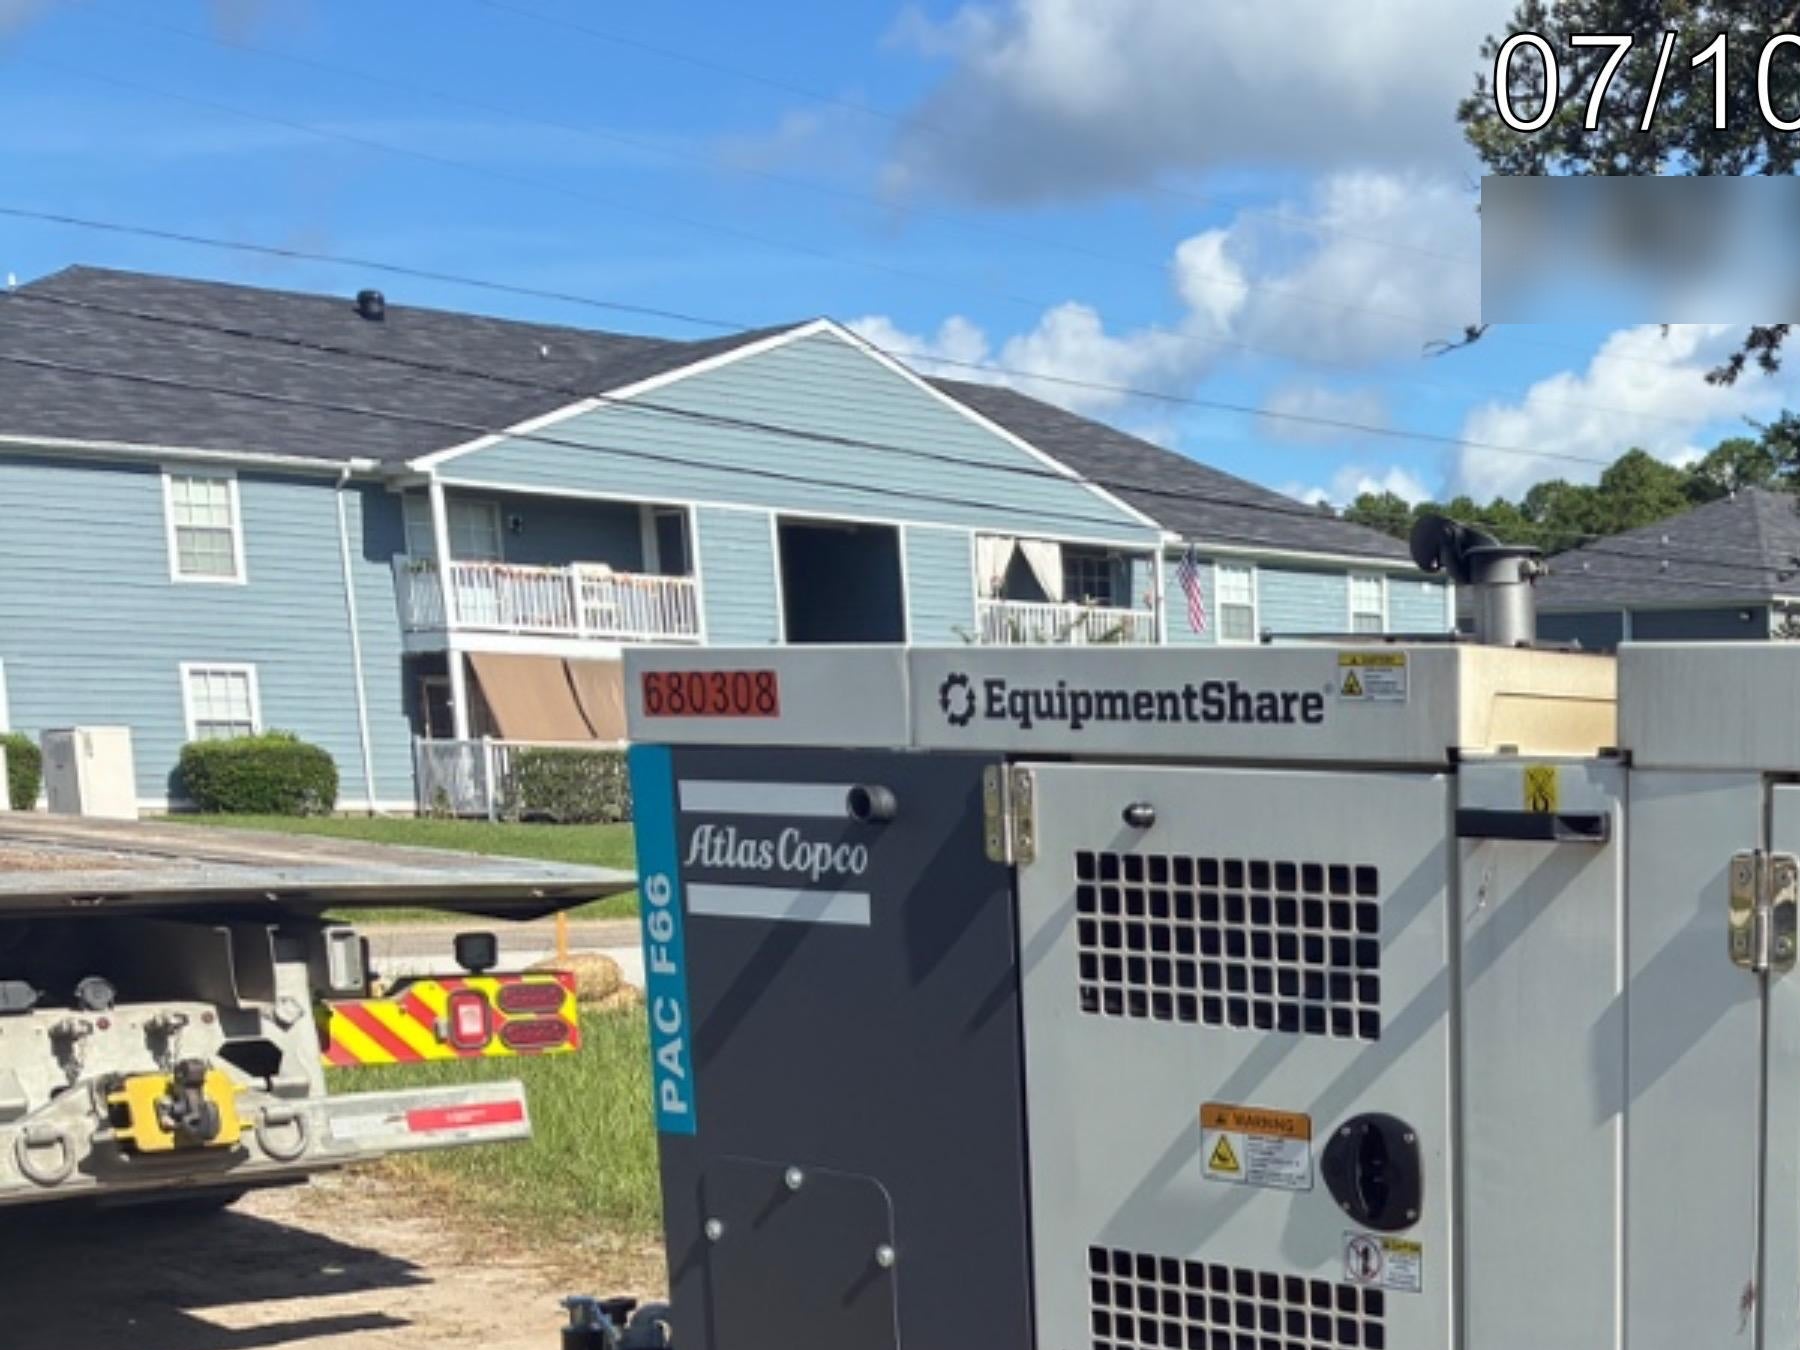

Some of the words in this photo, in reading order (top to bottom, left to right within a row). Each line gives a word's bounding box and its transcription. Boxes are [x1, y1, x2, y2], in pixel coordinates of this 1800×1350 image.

[643, 671, 776, 715] 680308
[983, 679, 1325, 730] EquipmentShare
[684, 824, 774, 868] Atlas
[778, 828, 869, 882] Copco
[645, 872, 676, 974] F66
[660, 996, 687, 1114] PAC
